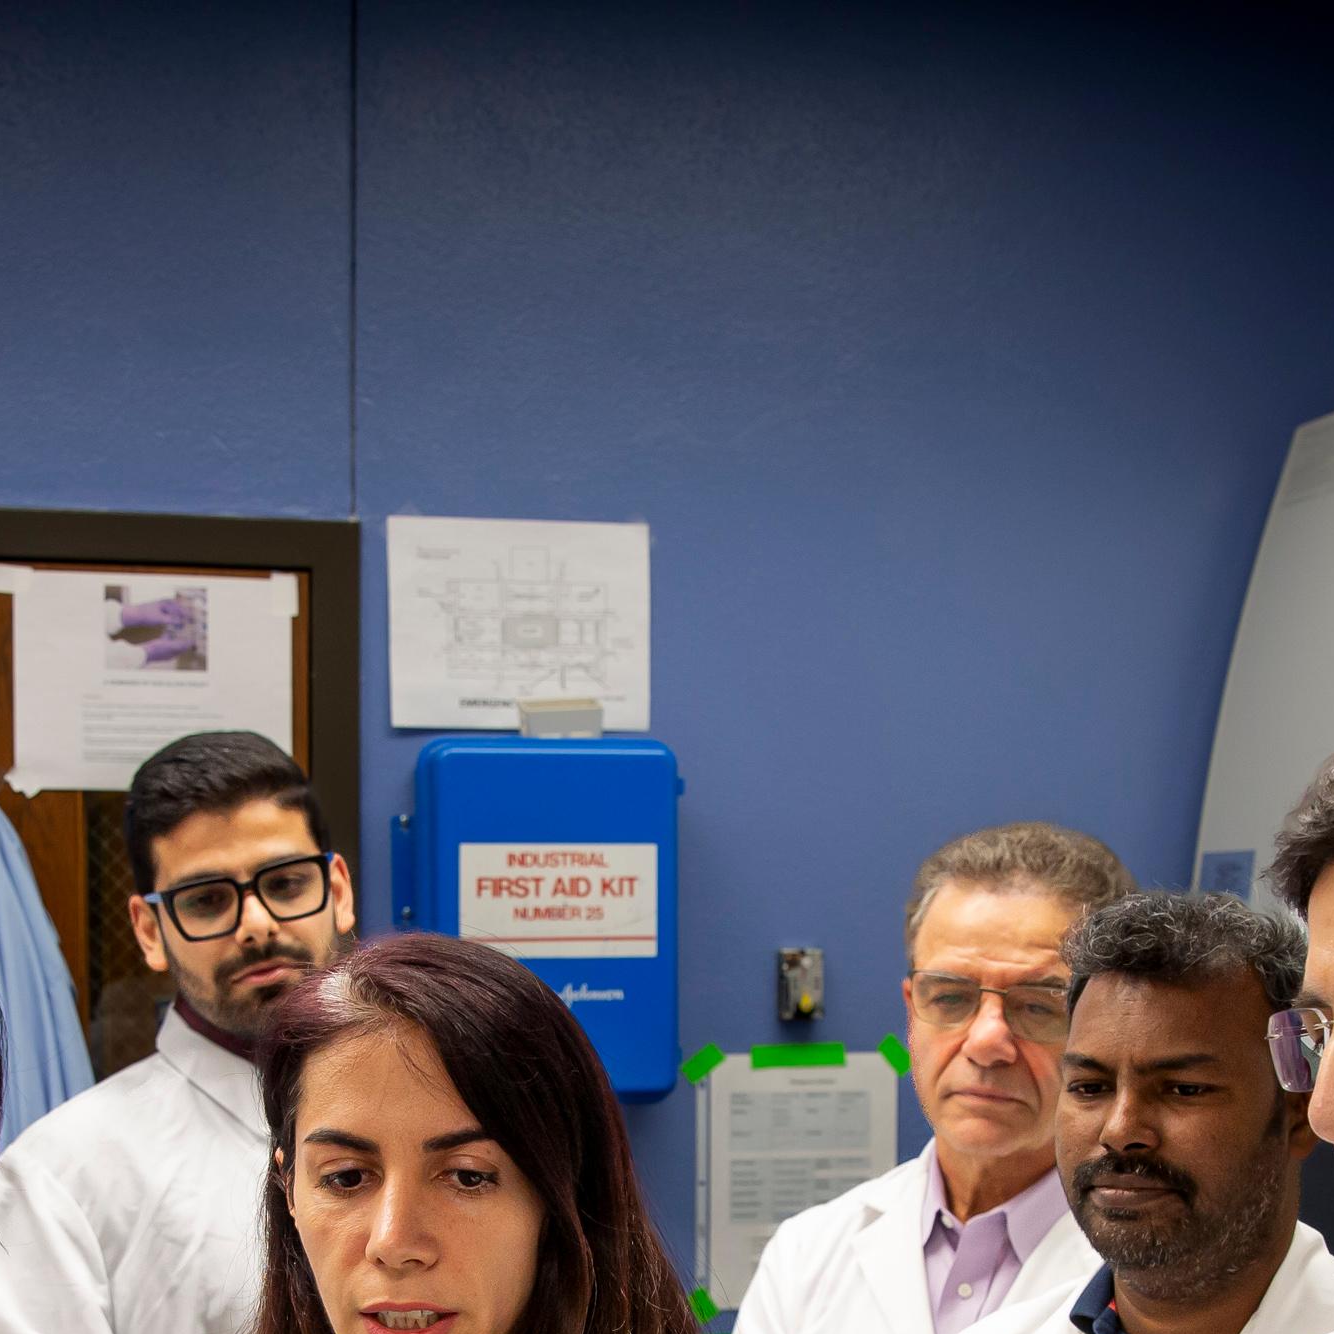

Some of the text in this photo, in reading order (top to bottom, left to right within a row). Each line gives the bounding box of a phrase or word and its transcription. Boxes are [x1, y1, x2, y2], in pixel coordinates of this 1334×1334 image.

[507, 852, 609, 868] INDUSTRIAL
[475, 876, 638, 898] FIRST AID KIT
[513, 904, 582, 921] NUMBER
